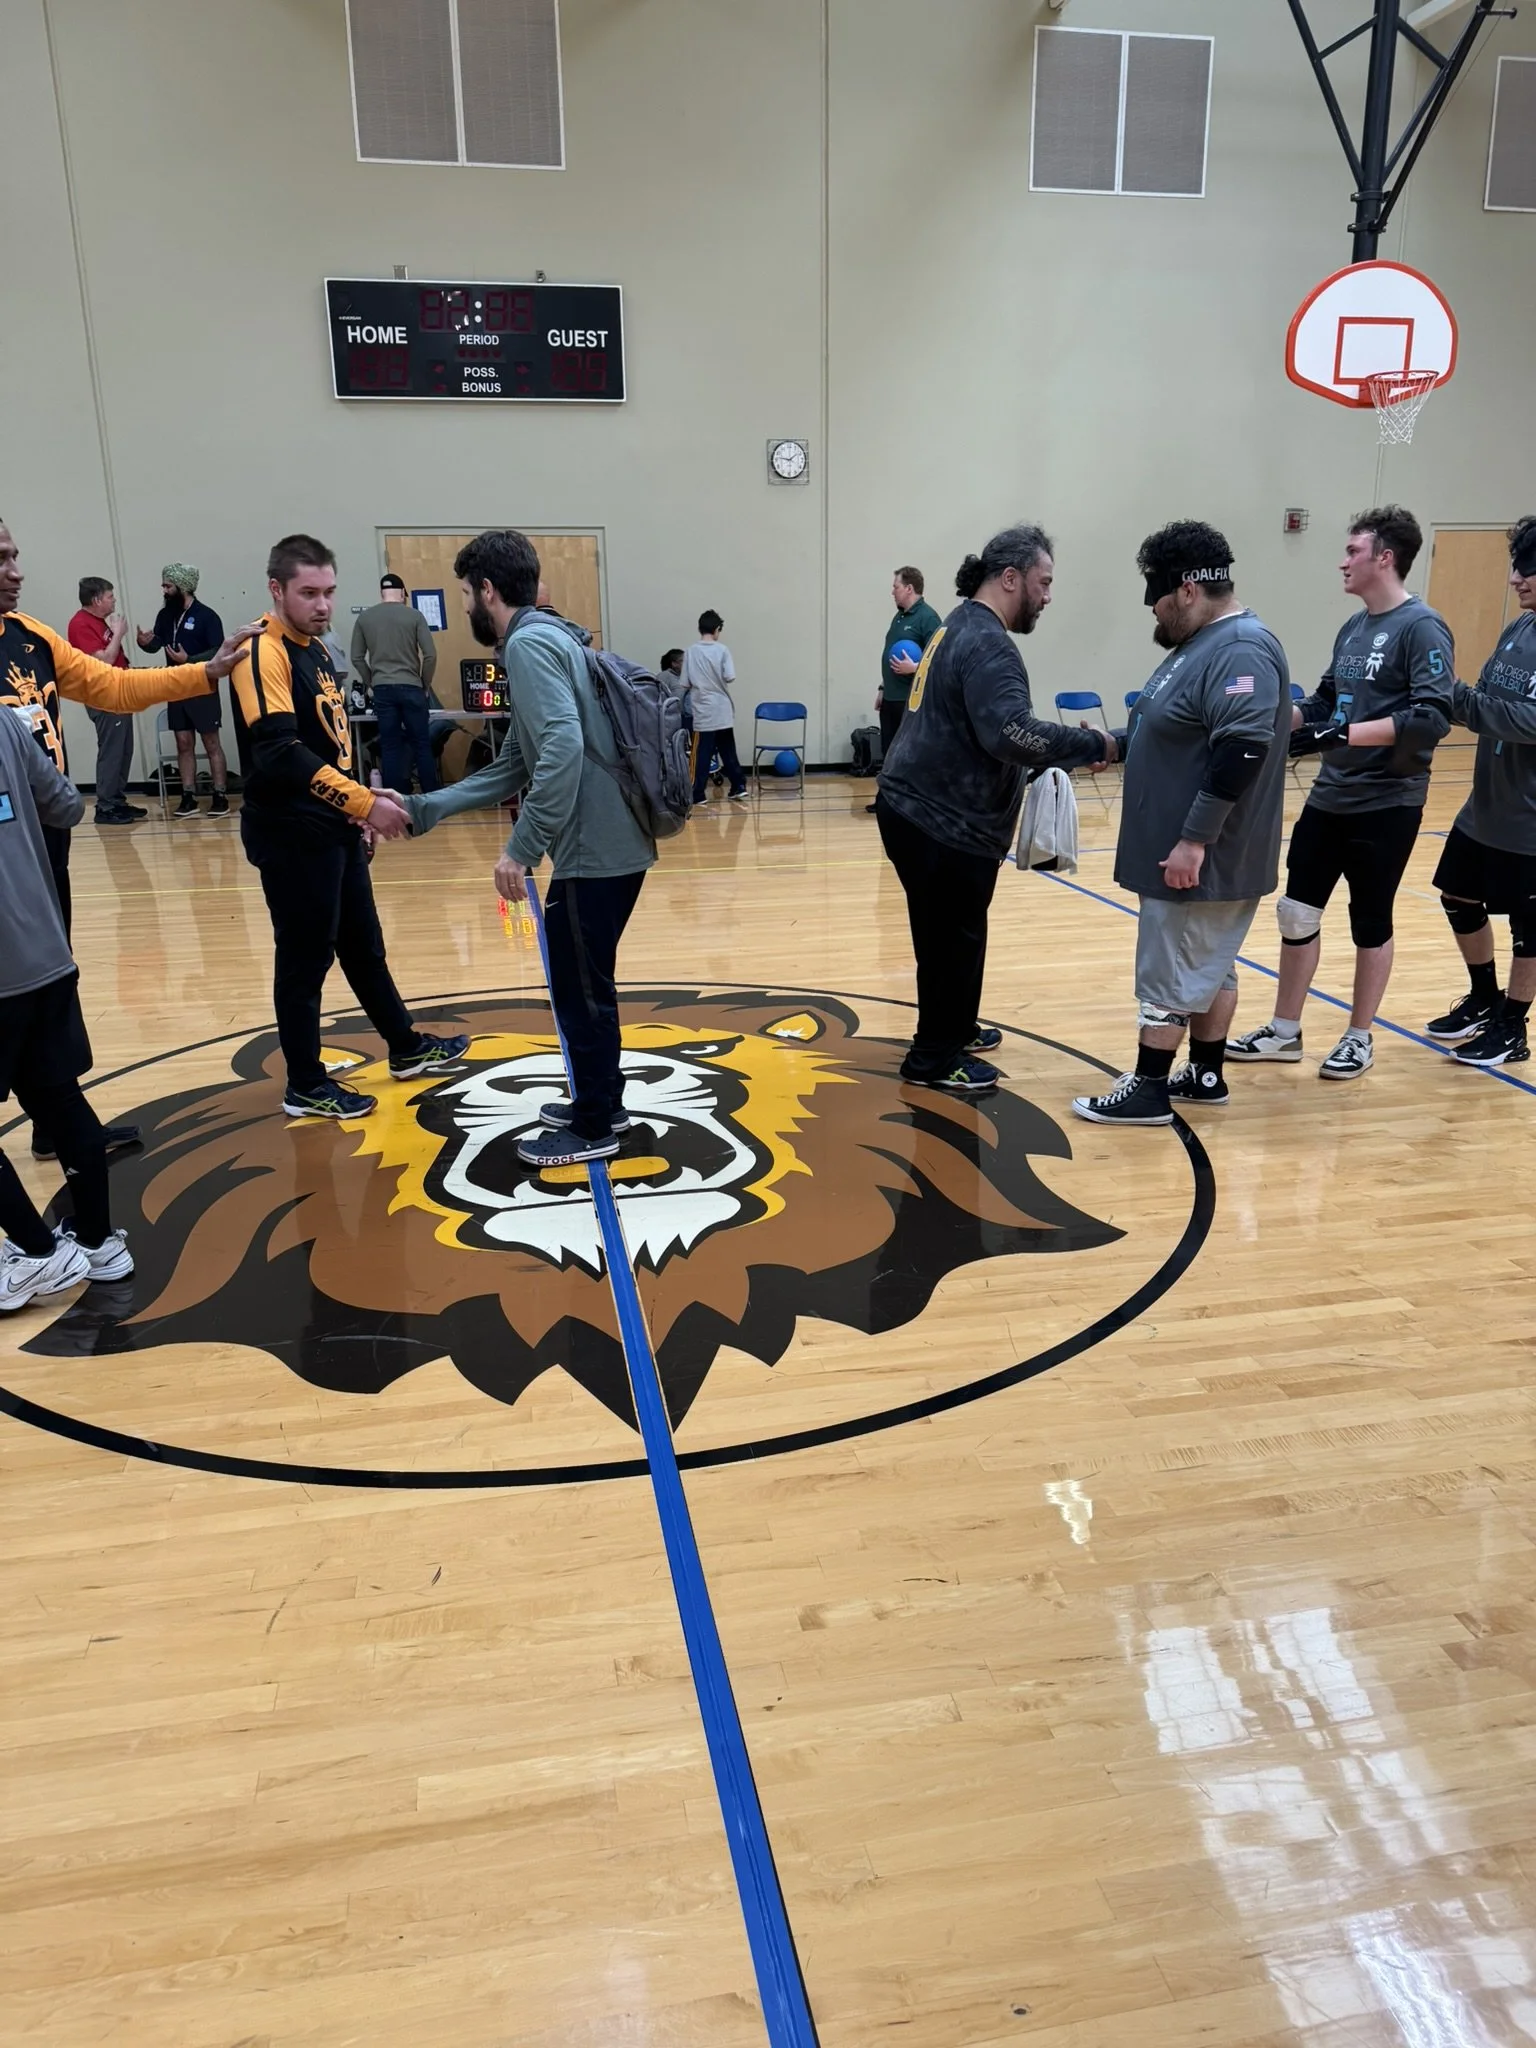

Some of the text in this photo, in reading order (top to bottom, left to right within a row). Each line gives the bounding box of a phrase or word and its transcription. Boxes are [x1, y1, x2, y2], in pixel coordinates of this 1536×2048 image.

[347, 325, 408, 344] HOME
[459, 334, 500, 346] PERIOD
[547, 328, 609, 348] GUEST
[463, 366, 499, 378] POSS.
[462, 381, 502, 393] BONUS
[1182, 567, 1228, 581] GOALFIX
[908, 626, 948, 713] 8
[1428, 649, 1444, 676] 5
[485, 663, 496, 682] 3
[470, 682, 490, 690] HOME
[484, 690, 493, 707] 0
[1002, 721, 1050, 753] SEATTLE
[537, 1154, 576, 1166] crocs
